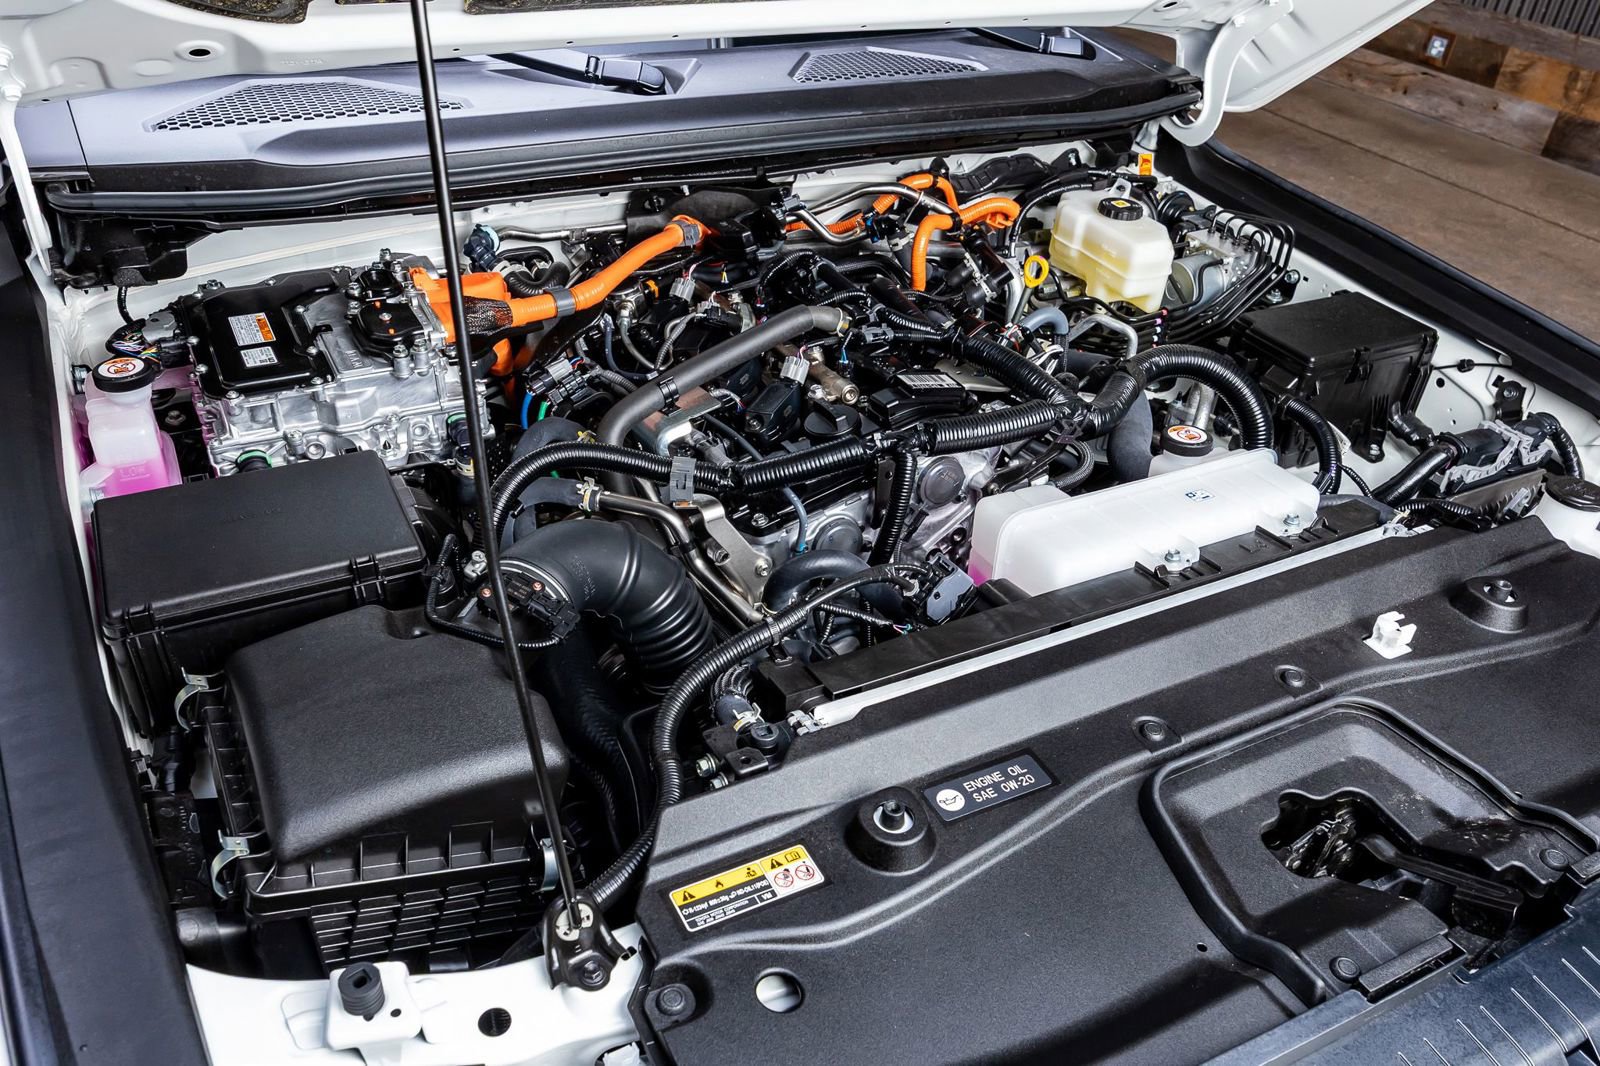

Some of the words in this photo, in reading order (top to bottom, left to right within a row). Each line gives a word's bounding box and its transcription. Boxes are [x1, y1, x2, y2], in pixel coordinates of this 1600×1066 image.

[963, 771, 1005, 792] ENGINE
[1007, 765, 1027, 776] OIL
[972, 787, 998, 802] SAE
[1000, 774, 1035, 792] 0W-20
